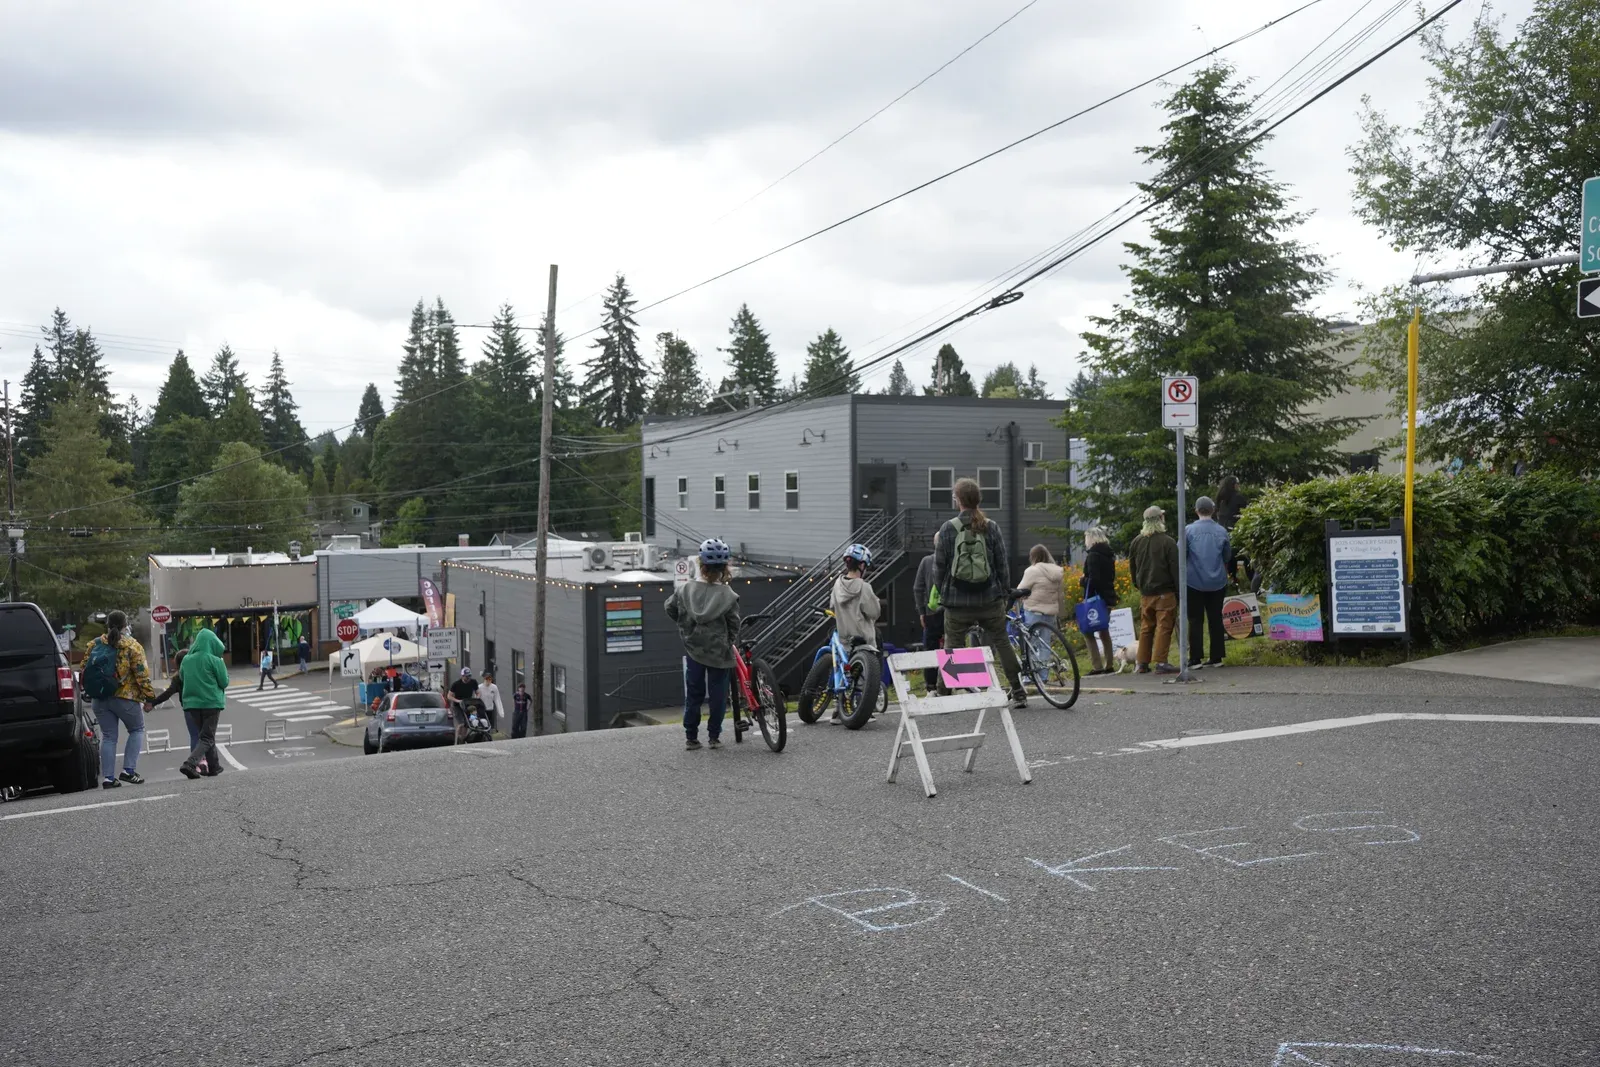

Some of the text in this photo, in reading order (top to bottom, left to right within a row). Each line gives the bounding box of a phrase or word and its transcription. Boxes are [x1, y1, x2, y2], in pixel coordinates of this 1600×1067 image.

[1241, 605, 1258, 615] SALE
[1269, 602, 1319, 616] Family Picnics
[1230, 615, 1243, 624] DAY
[337, 625, 358, 636] STOP
[343, 668, 359, 676] ONLY
[770, 810, 1421, 932] BIKES
